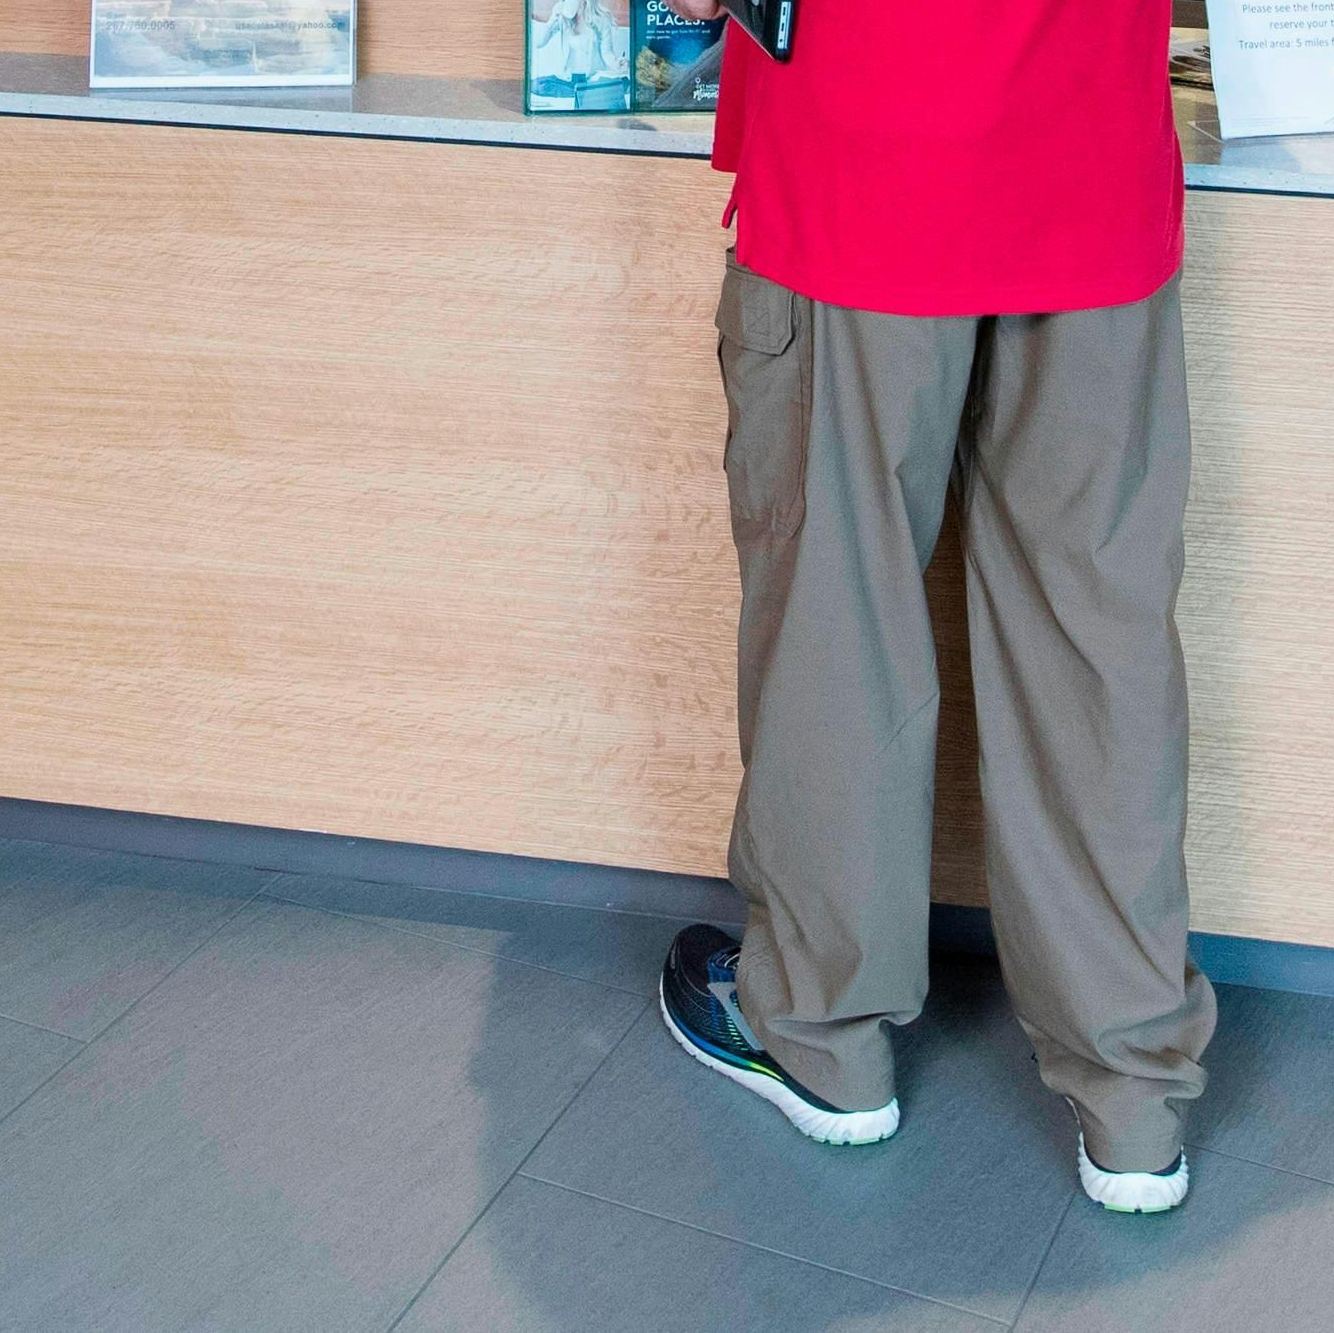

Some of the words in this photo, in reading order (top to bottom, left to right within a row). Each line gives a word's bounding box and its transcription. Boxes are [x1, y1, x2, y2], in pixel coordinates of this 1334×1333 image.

[1242, 4, 1272, 14] Please
[1274, 4, 1291, 13] see
[1293, 3, 1309, 12] the
[1310, 2, 1334, 12] front
[1269, 20, 1305, 30] reserve
[1306, 19, 1328, 30] your
[1238, 39, 1268, 51] Travel
[1295, 39, 1302, 48] 5
[1304, 37, 1329, 48] miles
